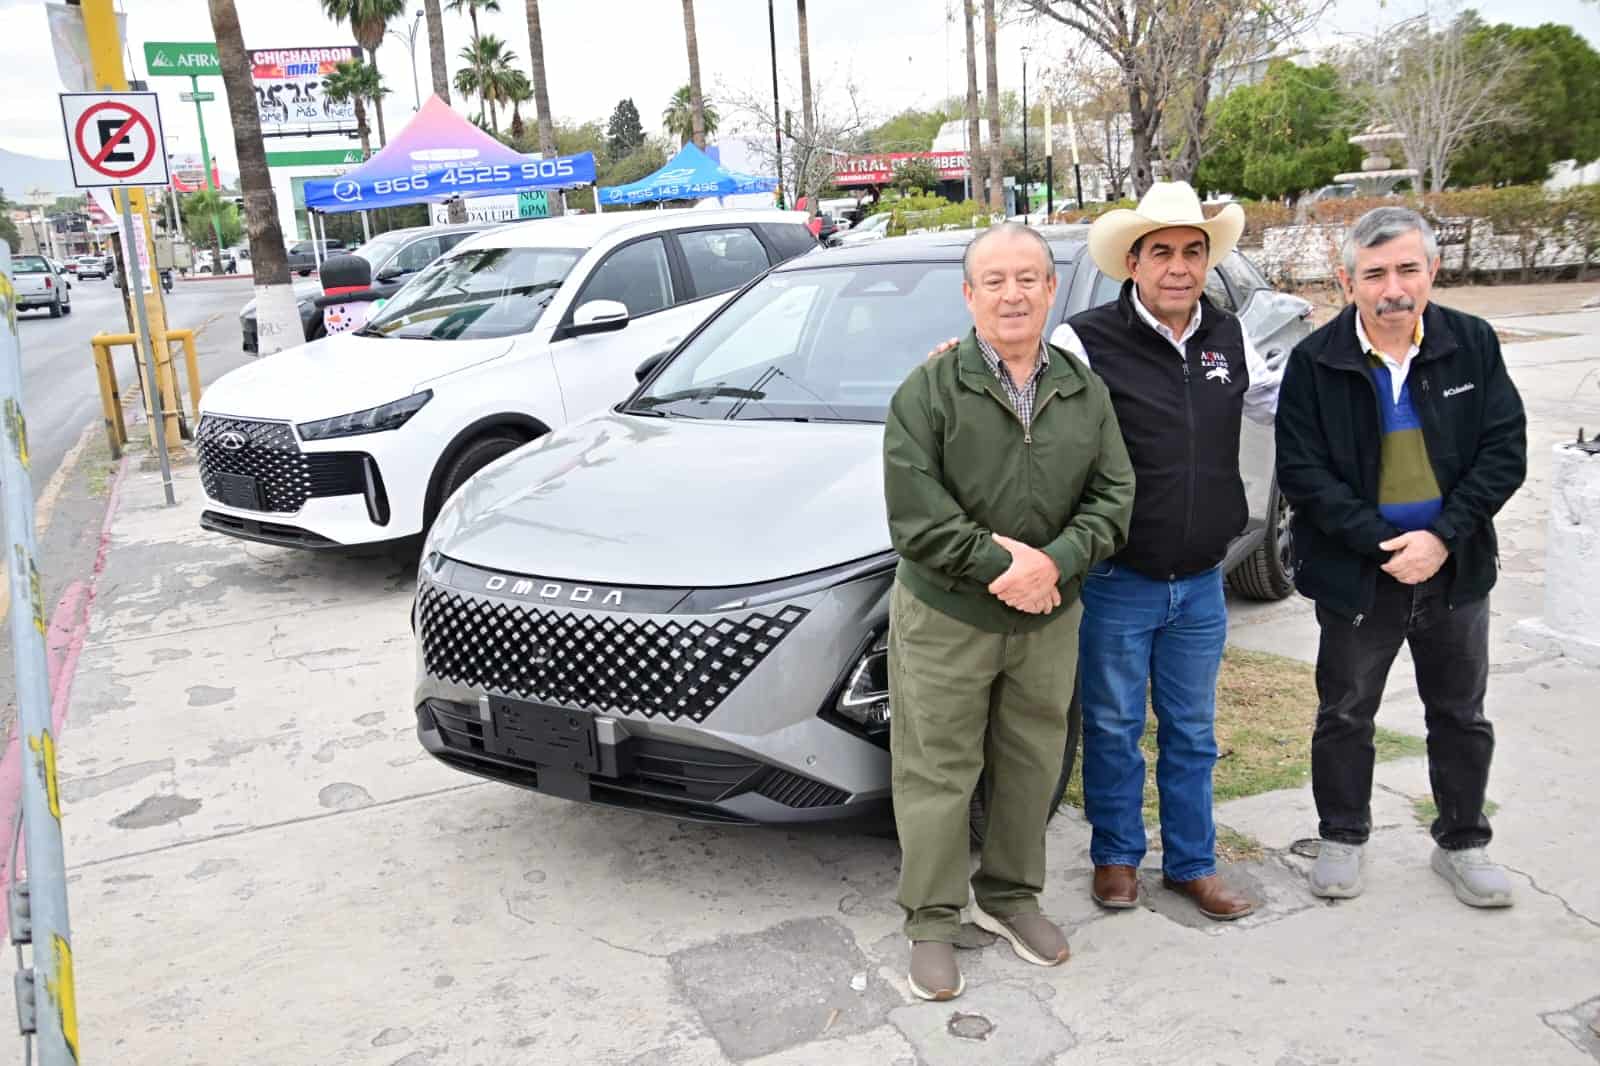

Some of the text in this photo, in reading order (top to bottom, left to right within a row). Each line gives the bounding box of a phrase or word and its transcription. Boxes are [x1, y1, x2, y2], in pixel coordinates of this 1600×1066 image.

[177, 53, 220, 67] AFIRM
[374, 160, 573, 194] 866 4525 905
[520, 204, 547, 216] 6PM
[485, 576, 623, 605] OMODA
